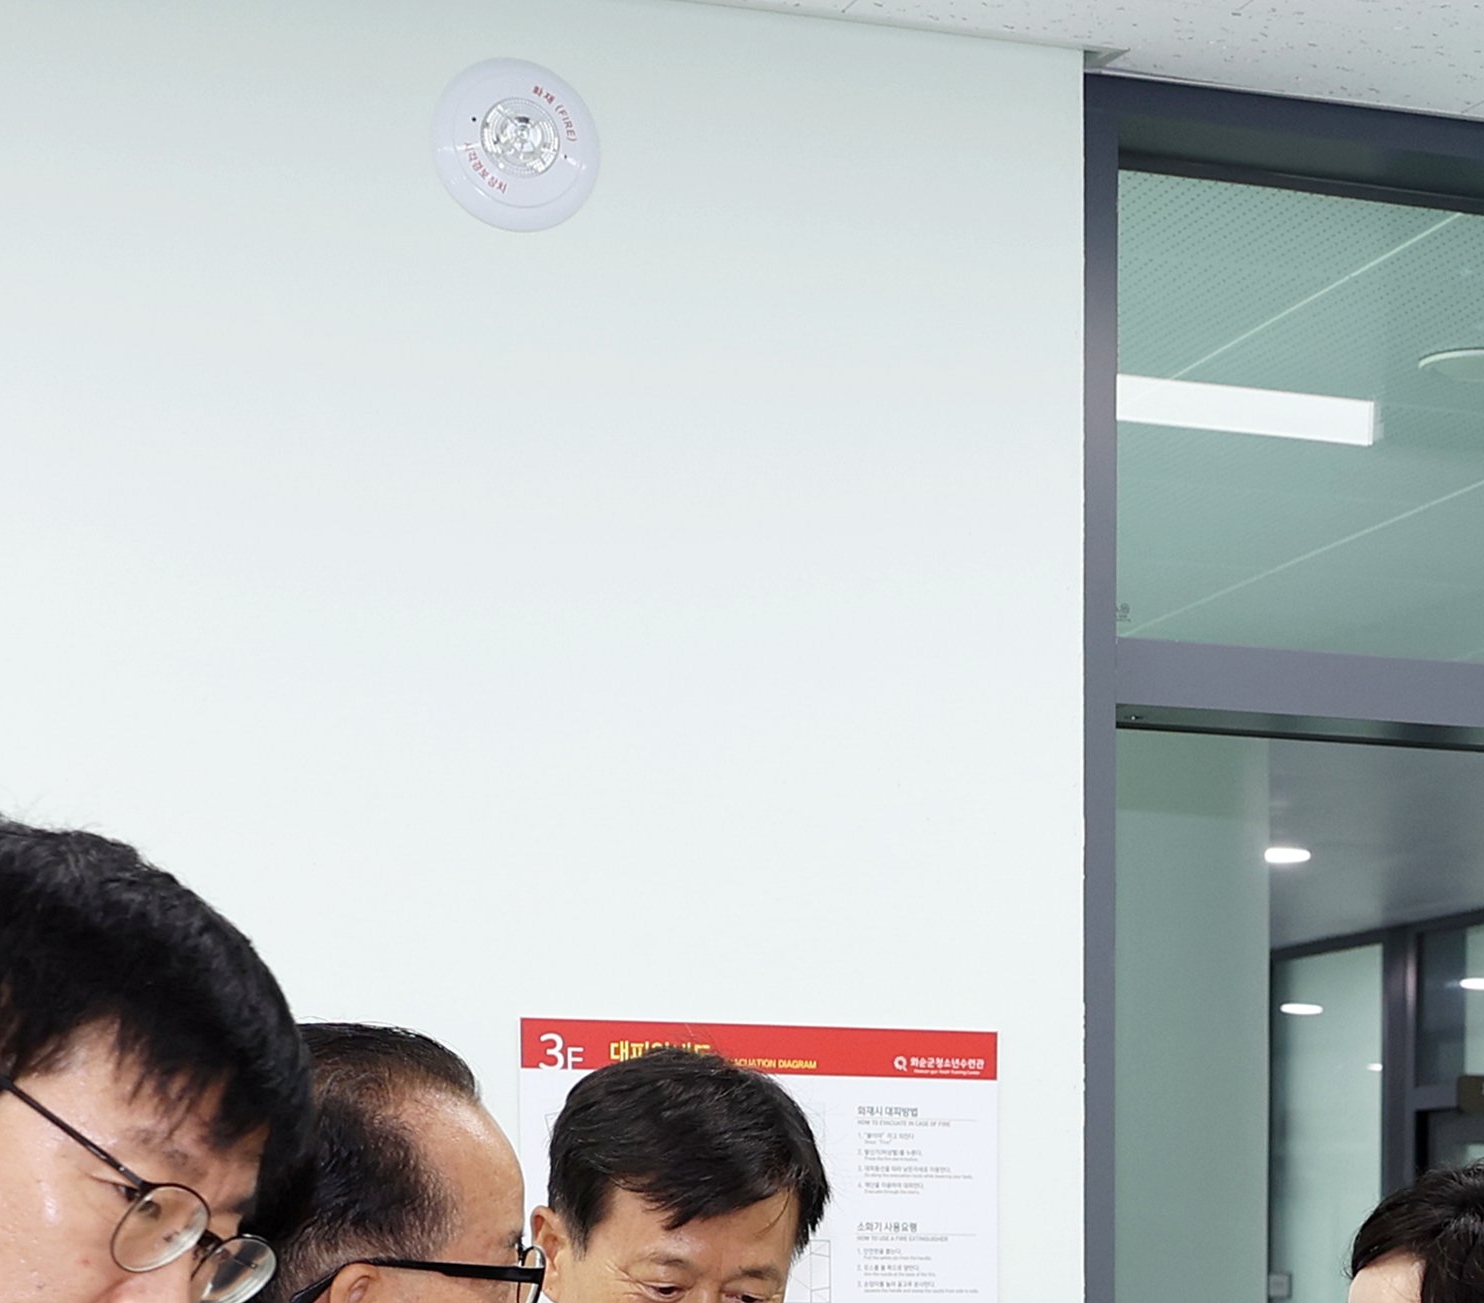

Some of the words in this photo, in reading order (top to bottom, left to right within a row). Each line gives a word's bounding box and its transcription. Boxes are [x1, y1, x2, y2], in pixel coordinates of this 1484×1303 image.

[555, 104, 578, 143] (FIRE)
[538, 1032, 585, 1071] 3F
[777, 1058, 817, 1070] DIAGRAM
[857, 1221, 882, 1233] 소화기
